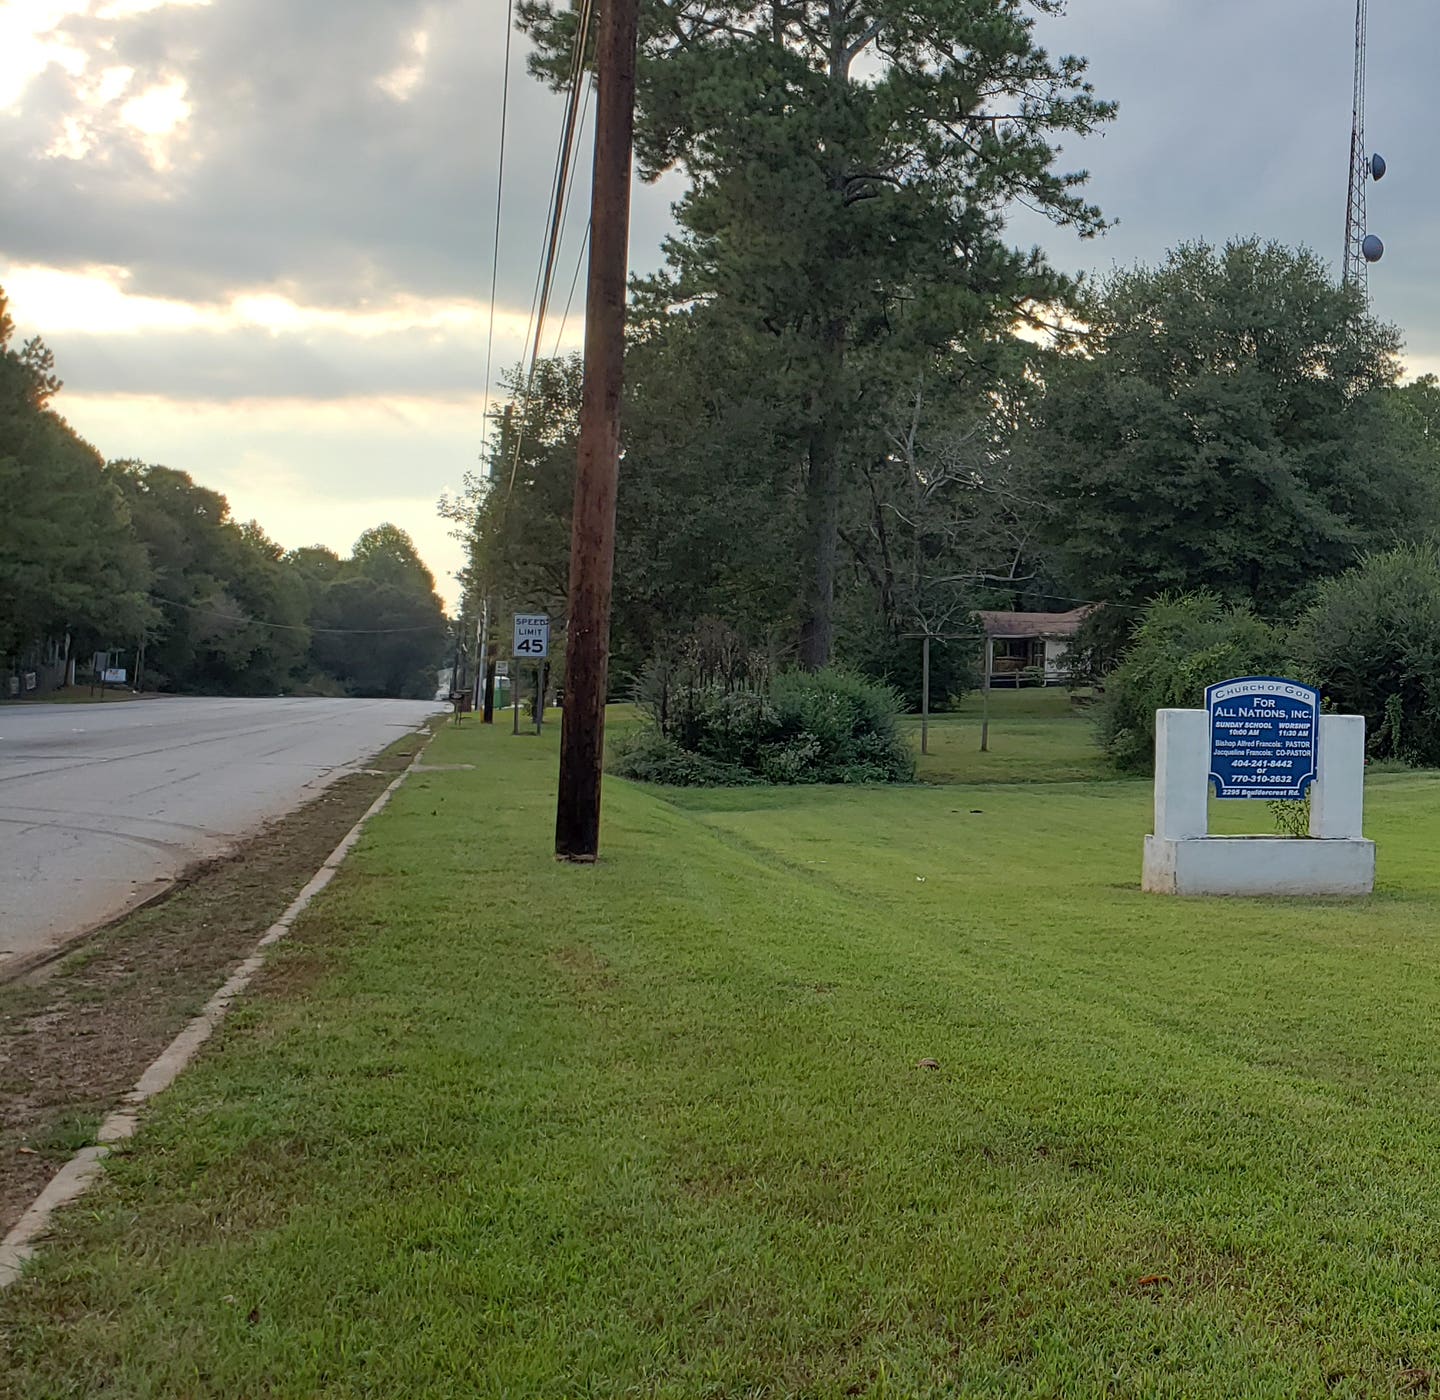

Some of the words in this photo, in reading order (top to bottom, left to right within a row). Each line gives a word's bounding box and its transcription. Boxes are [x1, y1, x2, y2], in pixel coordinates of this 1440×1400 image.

[517, 639, 543, 653] 45
[1215, 685, 1264, 698] CHURCH
[1285, 686, 1310, 700] GOD
[1253, 698, 1275, 707] FOR
[1215, 707, 1236, 717] ALL
[1238, 708, 1288, 719] NATIONS,
[1291, 710, 1312, 718] INC.
[1215, 740, 1236, 748] Bishop
